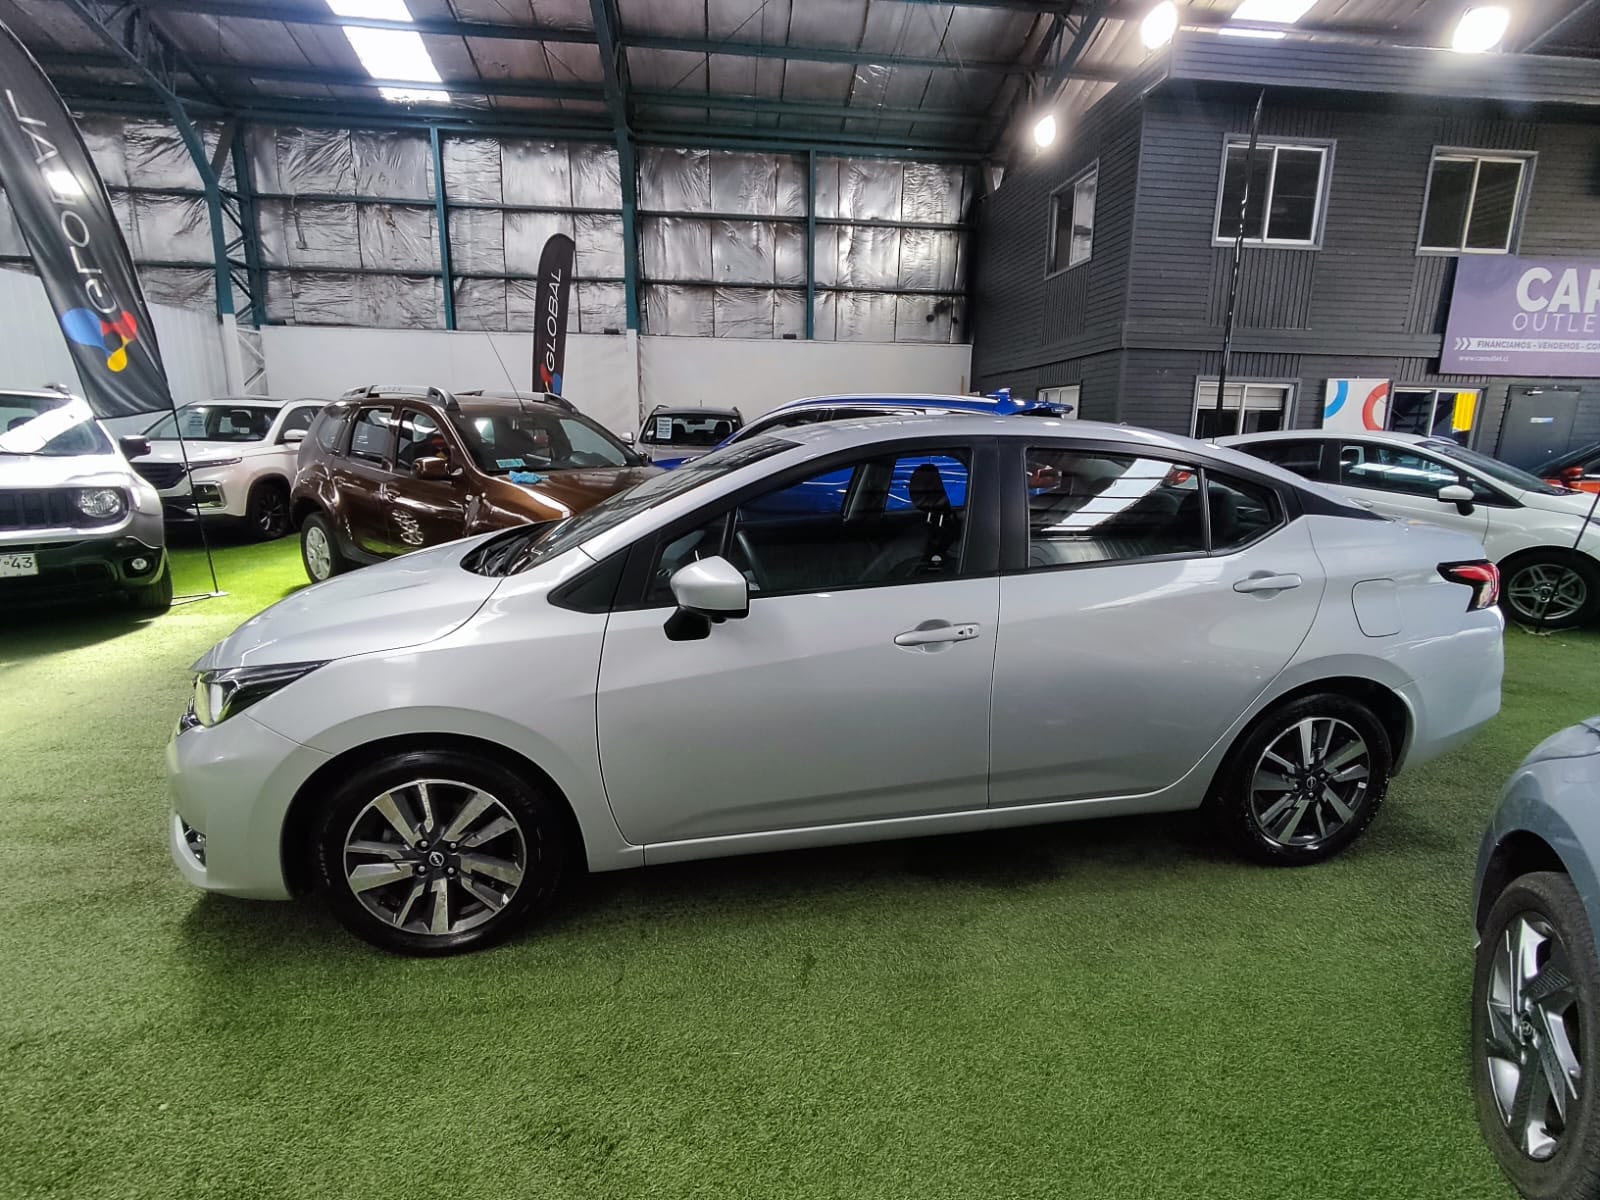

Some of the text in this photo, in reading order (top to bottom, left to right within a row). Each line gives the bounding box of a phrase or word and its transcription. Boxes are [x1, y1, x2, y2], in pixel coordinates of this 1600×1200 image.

[546, 268, 562, 372] GLOBAL
[1512, 312, 1598, 333] OUTLE
[1476, 340, 1532, 350] FINANCIAMOS
[1538, 341, 1580, 351] VENDEMOS
